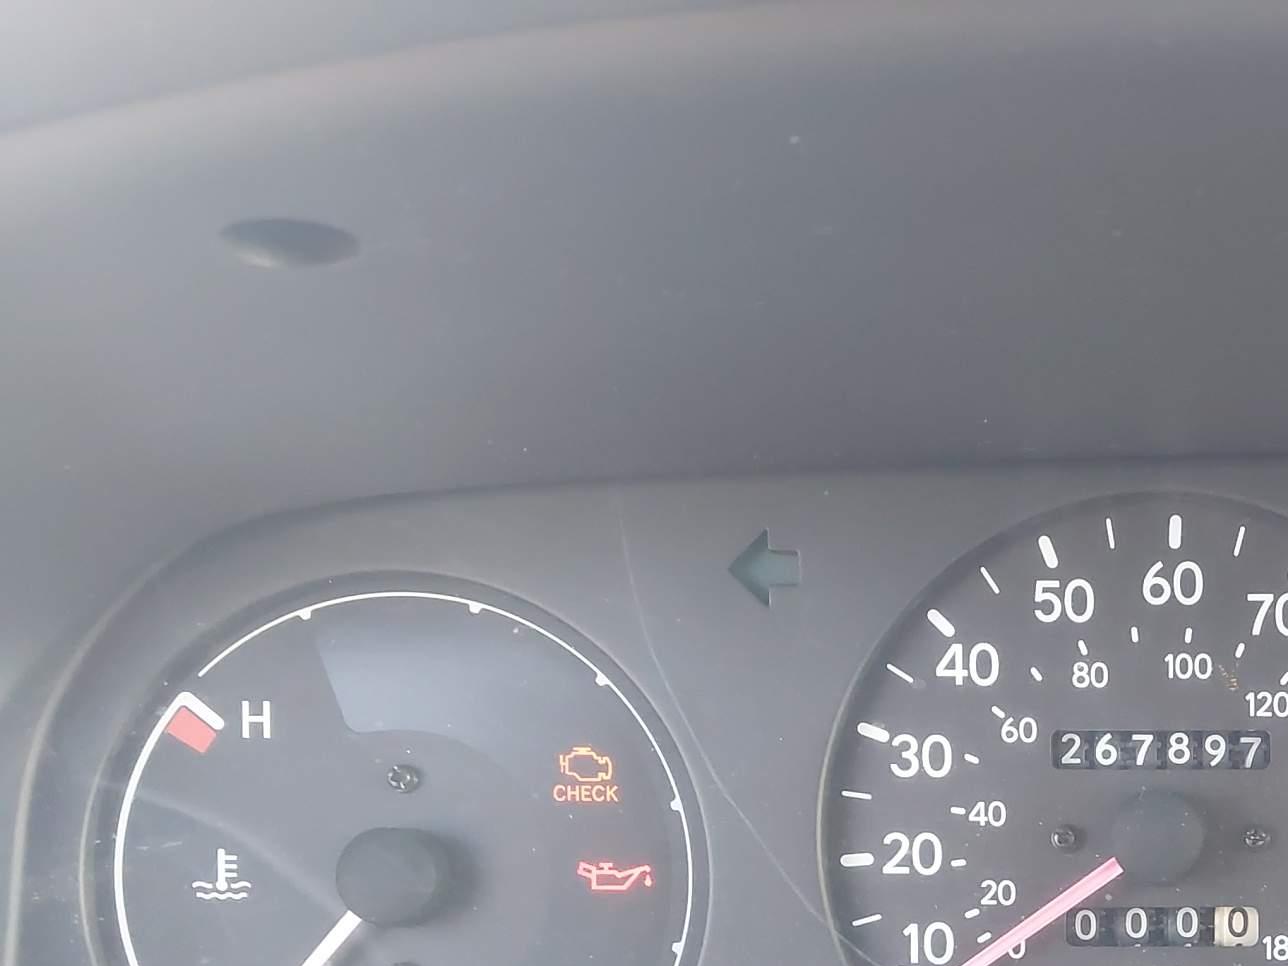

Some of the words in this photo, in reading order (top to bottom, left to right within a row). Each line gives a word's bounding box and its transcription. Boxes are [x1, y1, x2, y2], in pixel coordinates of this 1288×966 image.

[1033, 579, 1095, 623] 50
[1142, 561, 1203, 605] 60
[935, 642, 999, 686] 40
[1072, 661, 1109, 688] 80
[1164, 653, 1213, 680] 100
[241, 700, 272, 738] H
[1001, 717, 1037, 743] 60
[890, 734, 952, 778] 30
[553, 784, 618, 802] CHECK
[968, 801, 1007, 826] 40
[882, 832, 942, 876] 20
[980, 880, 1016, 906] 20
[903, 921, 954, 965] 10
